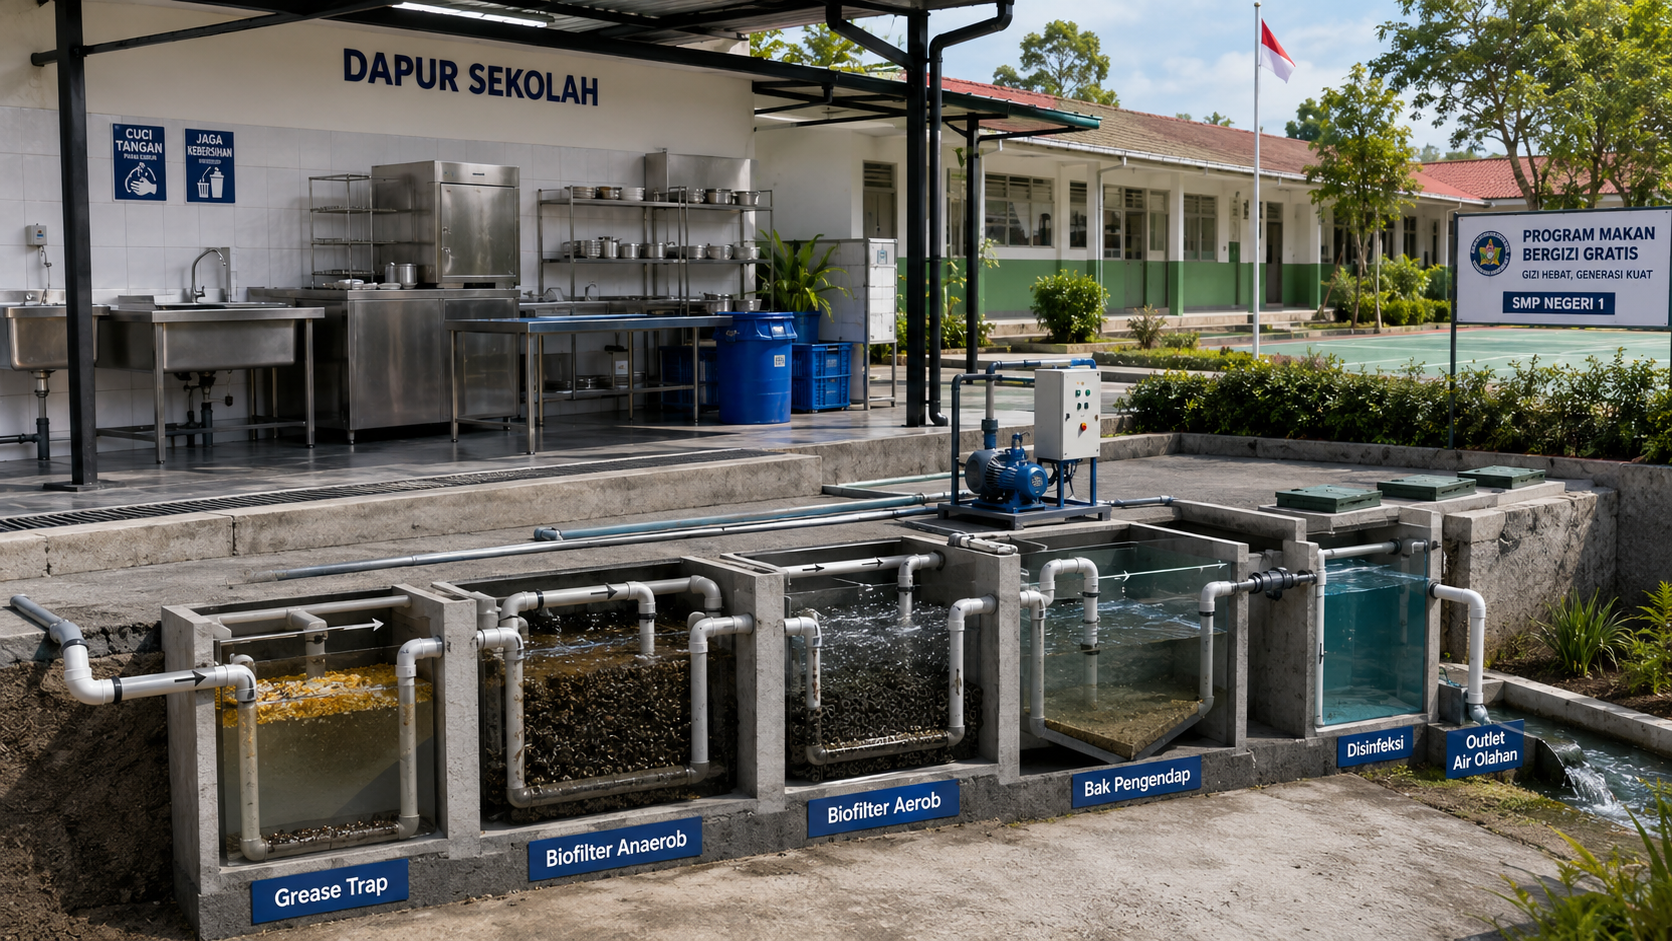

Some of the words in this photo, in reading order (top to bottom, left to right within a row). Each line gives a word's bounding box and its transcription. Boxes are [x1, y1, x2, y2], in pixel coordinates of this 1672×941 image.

[344, 48, 458, 92] DAPUR
[469, 63, 599, 107] SEKOLAH
[126, 128, 152, 140] CUCI
[196, 134, 223, 145] JAGA
[116, 140, 162, 154] TANGAN
[187, 146, 232, 158] KEBERSIHAN
[1523, 228, 1594, 242] PROGRAM
[1600, 226, 1656, 241] MAKAN
[1522, 247, 1578, 261] BERGIZI
[1583, 246, 1638, 261] GRATIS
[1522, 270, 1540, 280] GIZI
[1542, 270, 1573, 280] HEBAT,
[1576, 270, 1623, 280] GENERASI
[1626, 270, 1653, 279] KUAT
[1512, 297, 1540, 309] SMP
[1544, 297, 1594, 310] NEGERI
[1598, 298, 1604, 310] 1
[1347, 735, 1404, 758] Disinfeksi
[1466, 731, 1505, 750] Outlet
[1453, 754, 1472, 770] Air
[1474, 750, 1518, 766] Olahan
[1084, 778, 1110, 797] Bak
[1114, 768, 1190, 792] Pengendap
[828, 801, 890, 824] Biofilter
[894, 792, 941, 814] Aerob
[546, 840, 613, 868] Biofilter
[617, 830, 688, 857] Anaerob
[274, 883, 341, 908] Grease
[346, 874, 388, 898] Trap
